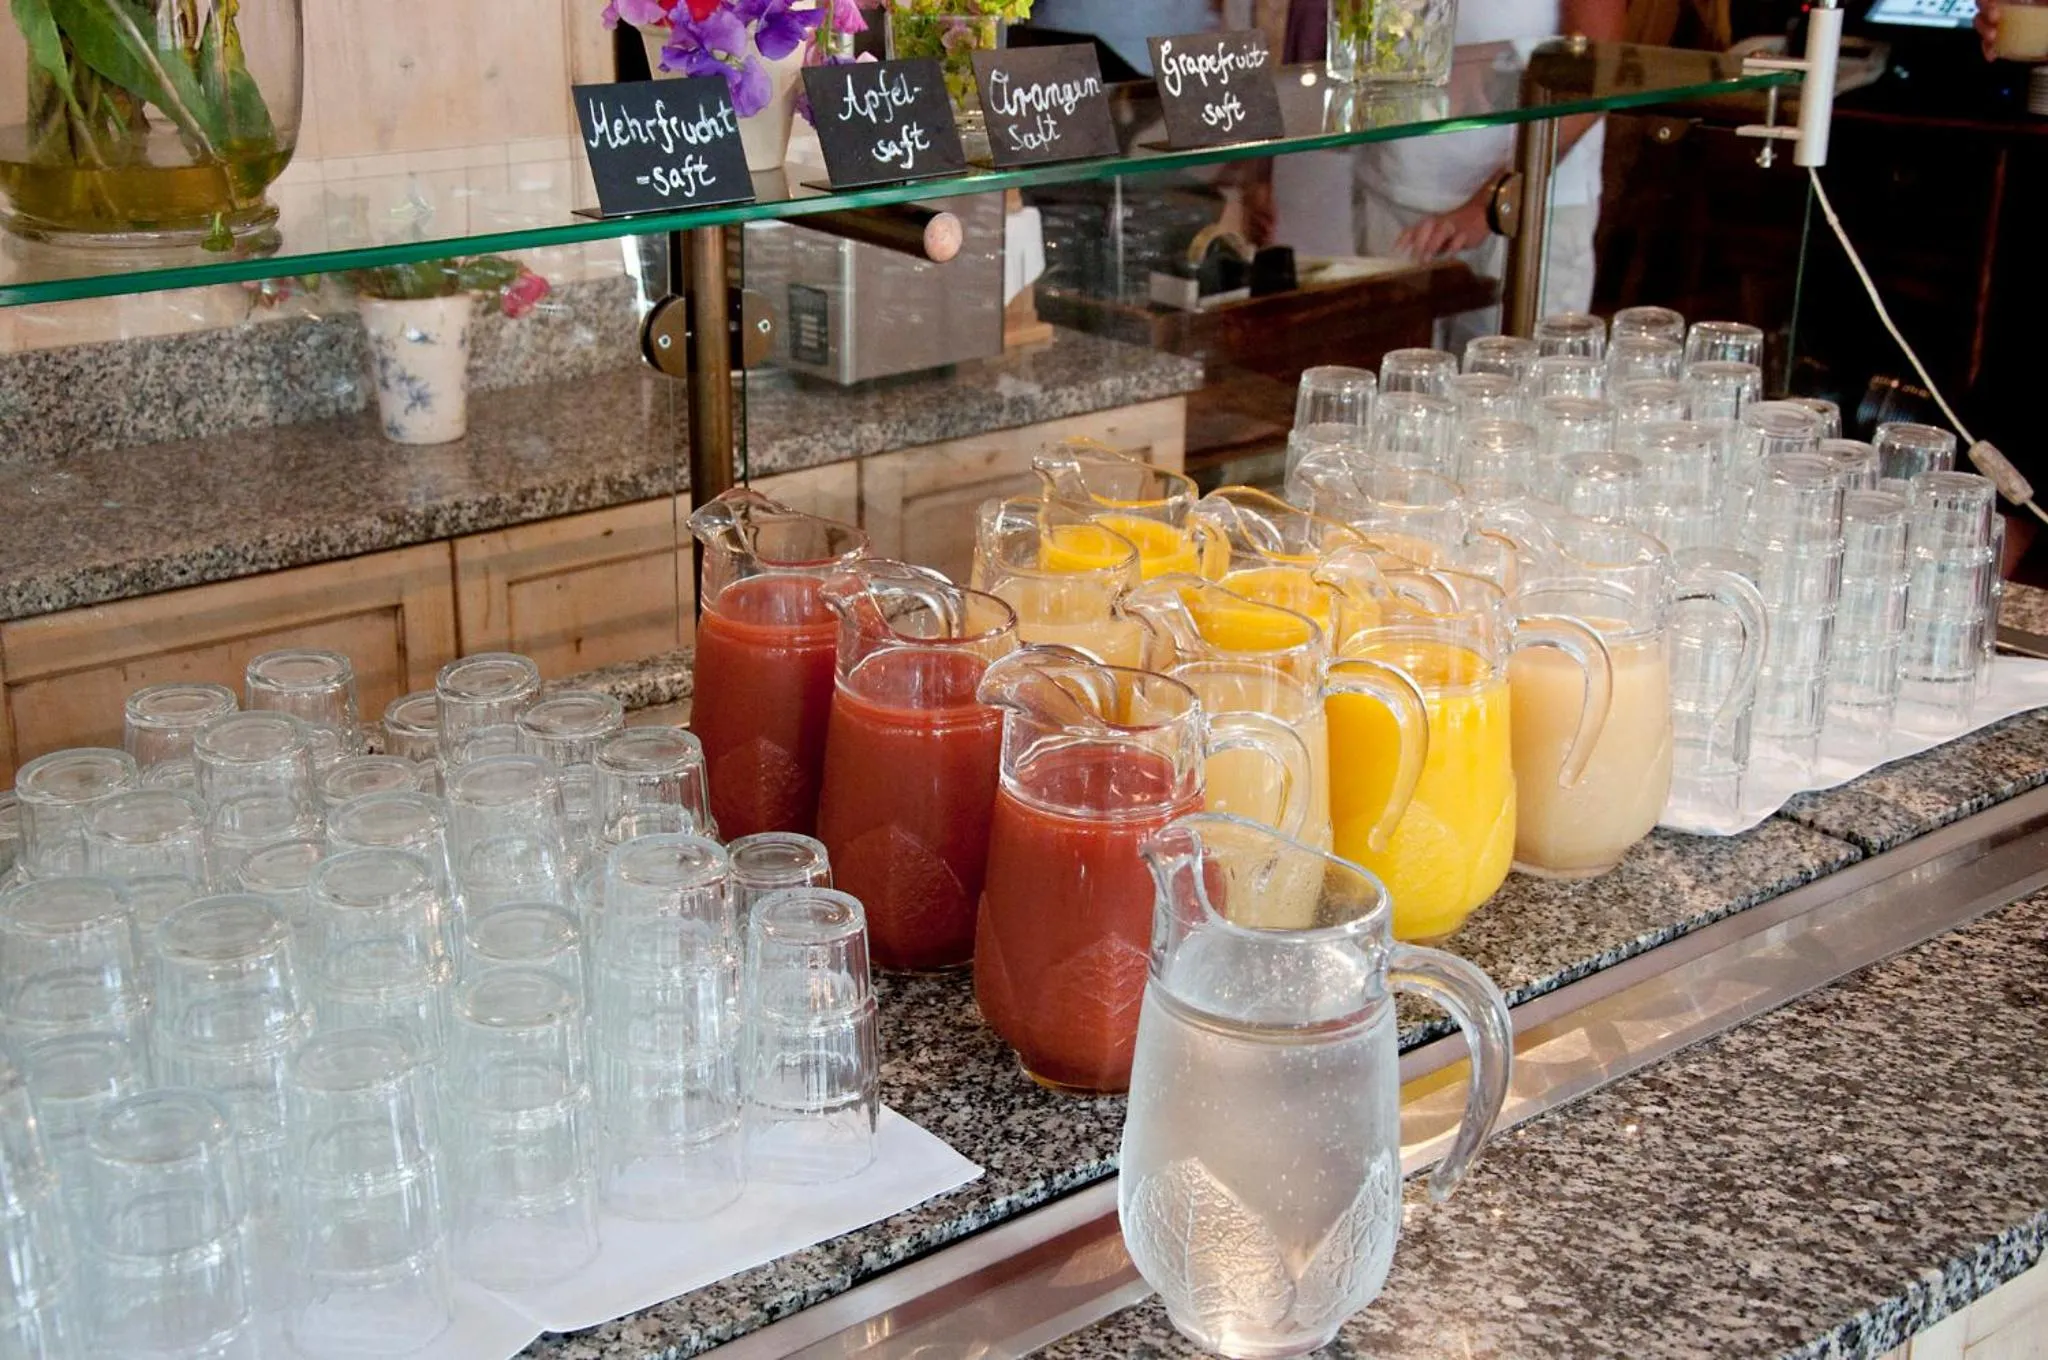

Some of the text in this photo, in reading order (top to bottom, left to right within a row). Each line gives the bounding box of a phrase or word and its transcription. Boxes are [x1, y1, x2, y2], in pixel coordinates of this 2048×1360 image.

[1160, 40, 1269, 97] Grapefruit-
[838, 69, 922, 122] Apfel-
[1201, 91, 1246, 132] saft
[871, 126, 930, 169] saft
[636, 155, 716, 197] -saft
